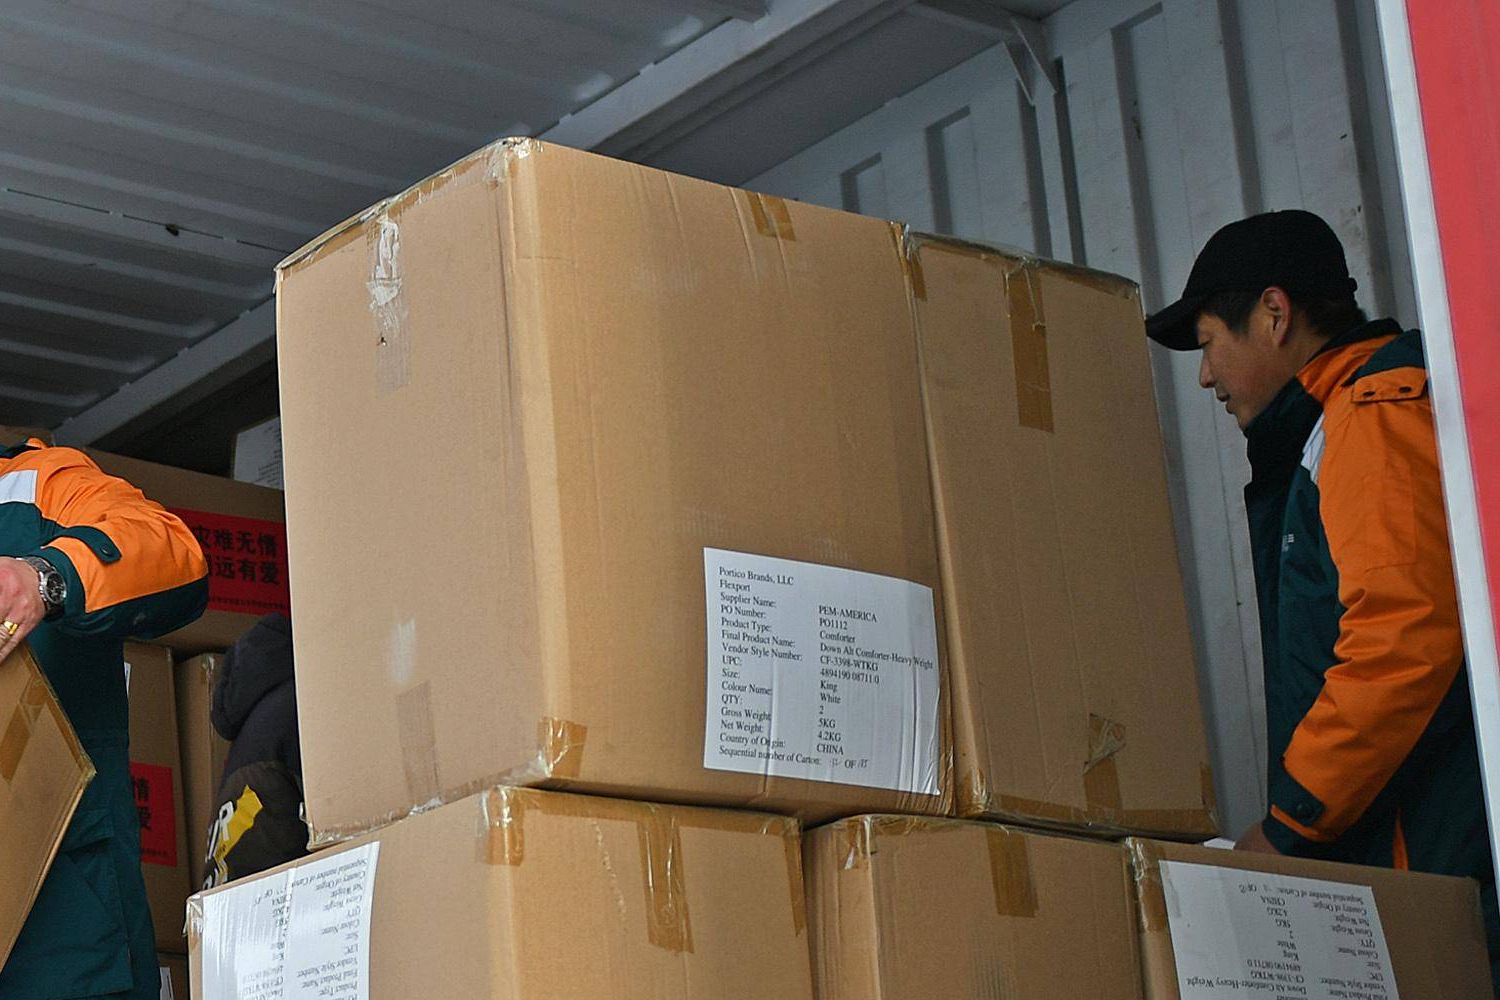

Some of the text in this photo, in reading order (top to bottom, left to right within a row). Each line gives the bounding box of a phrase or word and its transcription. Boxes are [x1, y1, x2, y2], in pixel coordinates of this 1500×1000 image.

[720, 567, 794, 585] Portico Brands, LLC
[720, 580, 750, 591] Flexport
[721, 592, 877, 622] Supplier Name: PEM-AMERICA
[721, 605, 847, 630] PO Number: PO1112
[721, 617, 855, 643] Product Type: Comforter
[722, 630, 740, 640] Final
[742, 632, 770, 644] Product
[772, 636, 795, 647] Name:
[821, 643, 841, 652] Down
[844, 646, 854, 655] Alt
[913, 656, 932, 670] Weight
[722, 643, 748, 653] Vendor
[751, 646, 769, 657] Style
[771, 649, 802, 661] Number:
[723, 655, 742, 666] UPC:
[722, 668, 837, 692] Size: King
[722, 681, 747, 692] Colour
[820, 693, 841, 704] White
[722, 694, 824, 714] QTY: 2
[721, 706, 742, 717] Gross
[818, 718, 836, 728] 5KG
[721, 720, 841, 742] Net Weight: 4.2KG
[720, 733, 748, 746] Country
[751, 736, 759, 744] of
[817, 744, 843, 755] CHINA
[719, 746, 756, 757] Sequential
[787, 753, 794, 761] of
[845, 760, 856, 768] OF
[1187, 977, 1214, 988] Weight
